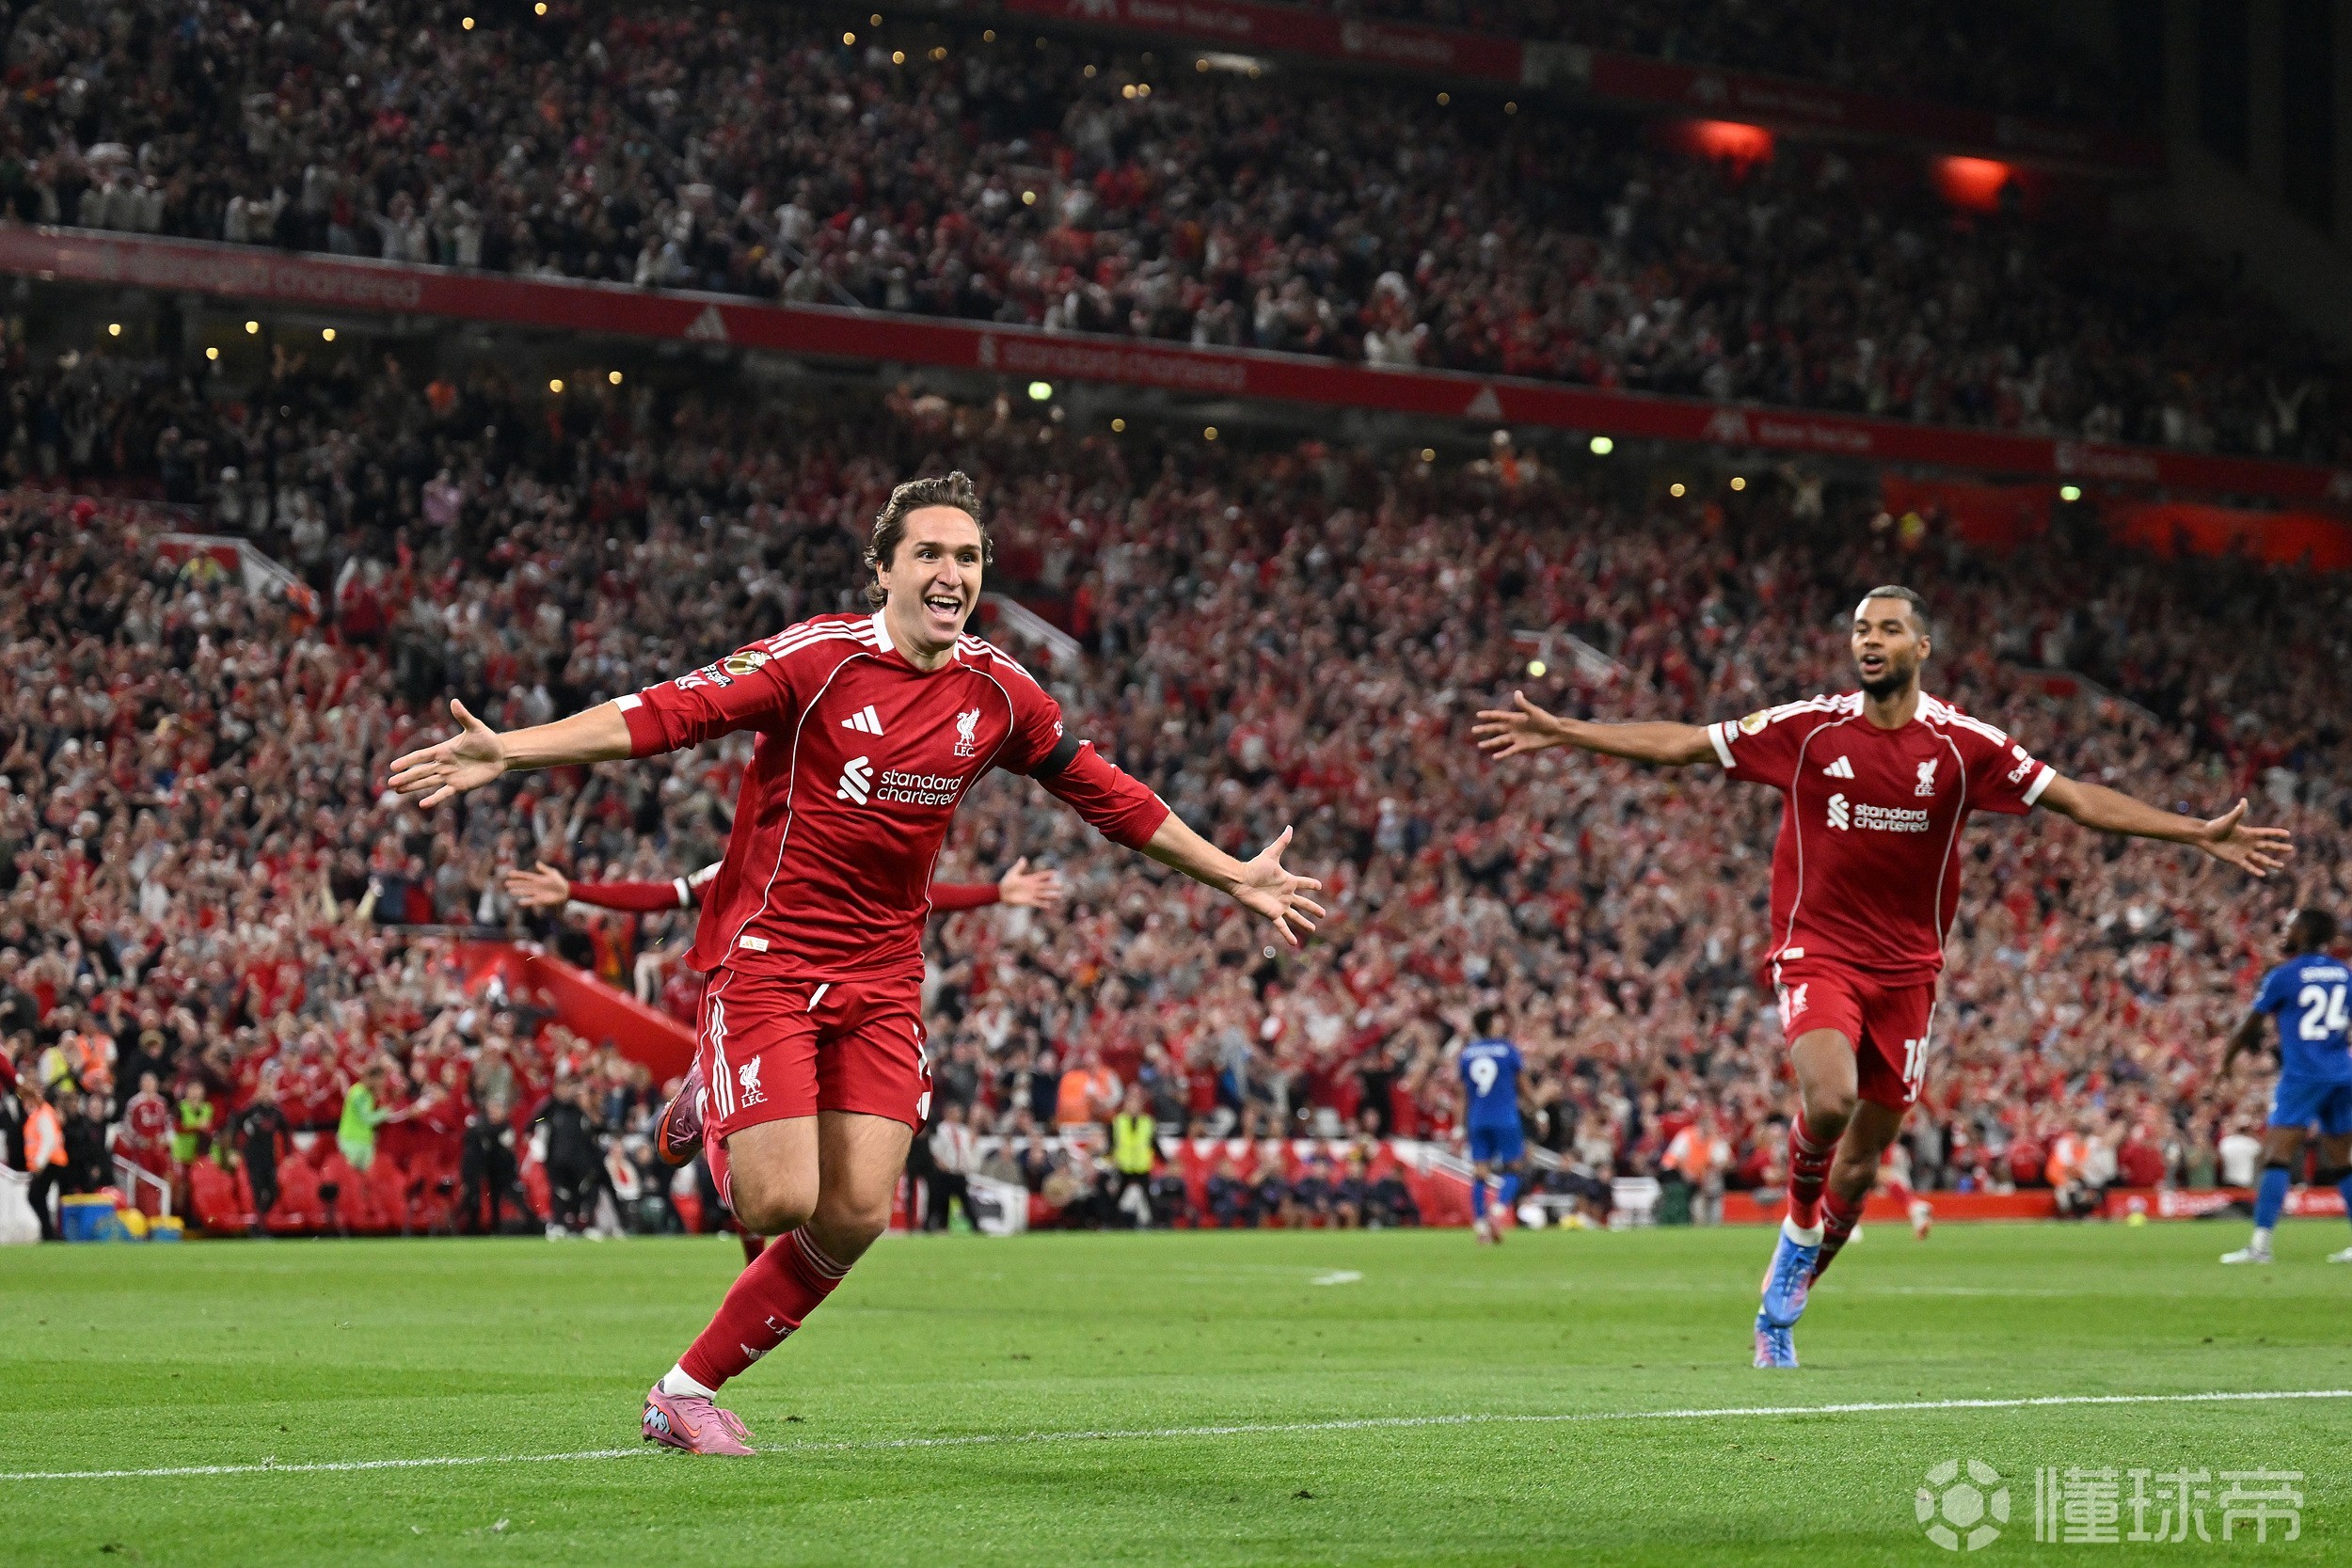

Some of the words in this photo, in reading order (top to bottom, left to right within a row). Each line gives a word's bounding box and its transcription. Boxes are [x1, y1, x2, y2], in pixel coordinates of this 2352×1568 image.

[881, 768, 963, 791] standard
[877, 785, 960, 805] chartered
[1853, 802, 1928, 821] standard
[1853, 816, 1930, 833] chartered
[2297, 984, 2350, 1041] 24
[1469, 1055, 1499, 1099] 9
